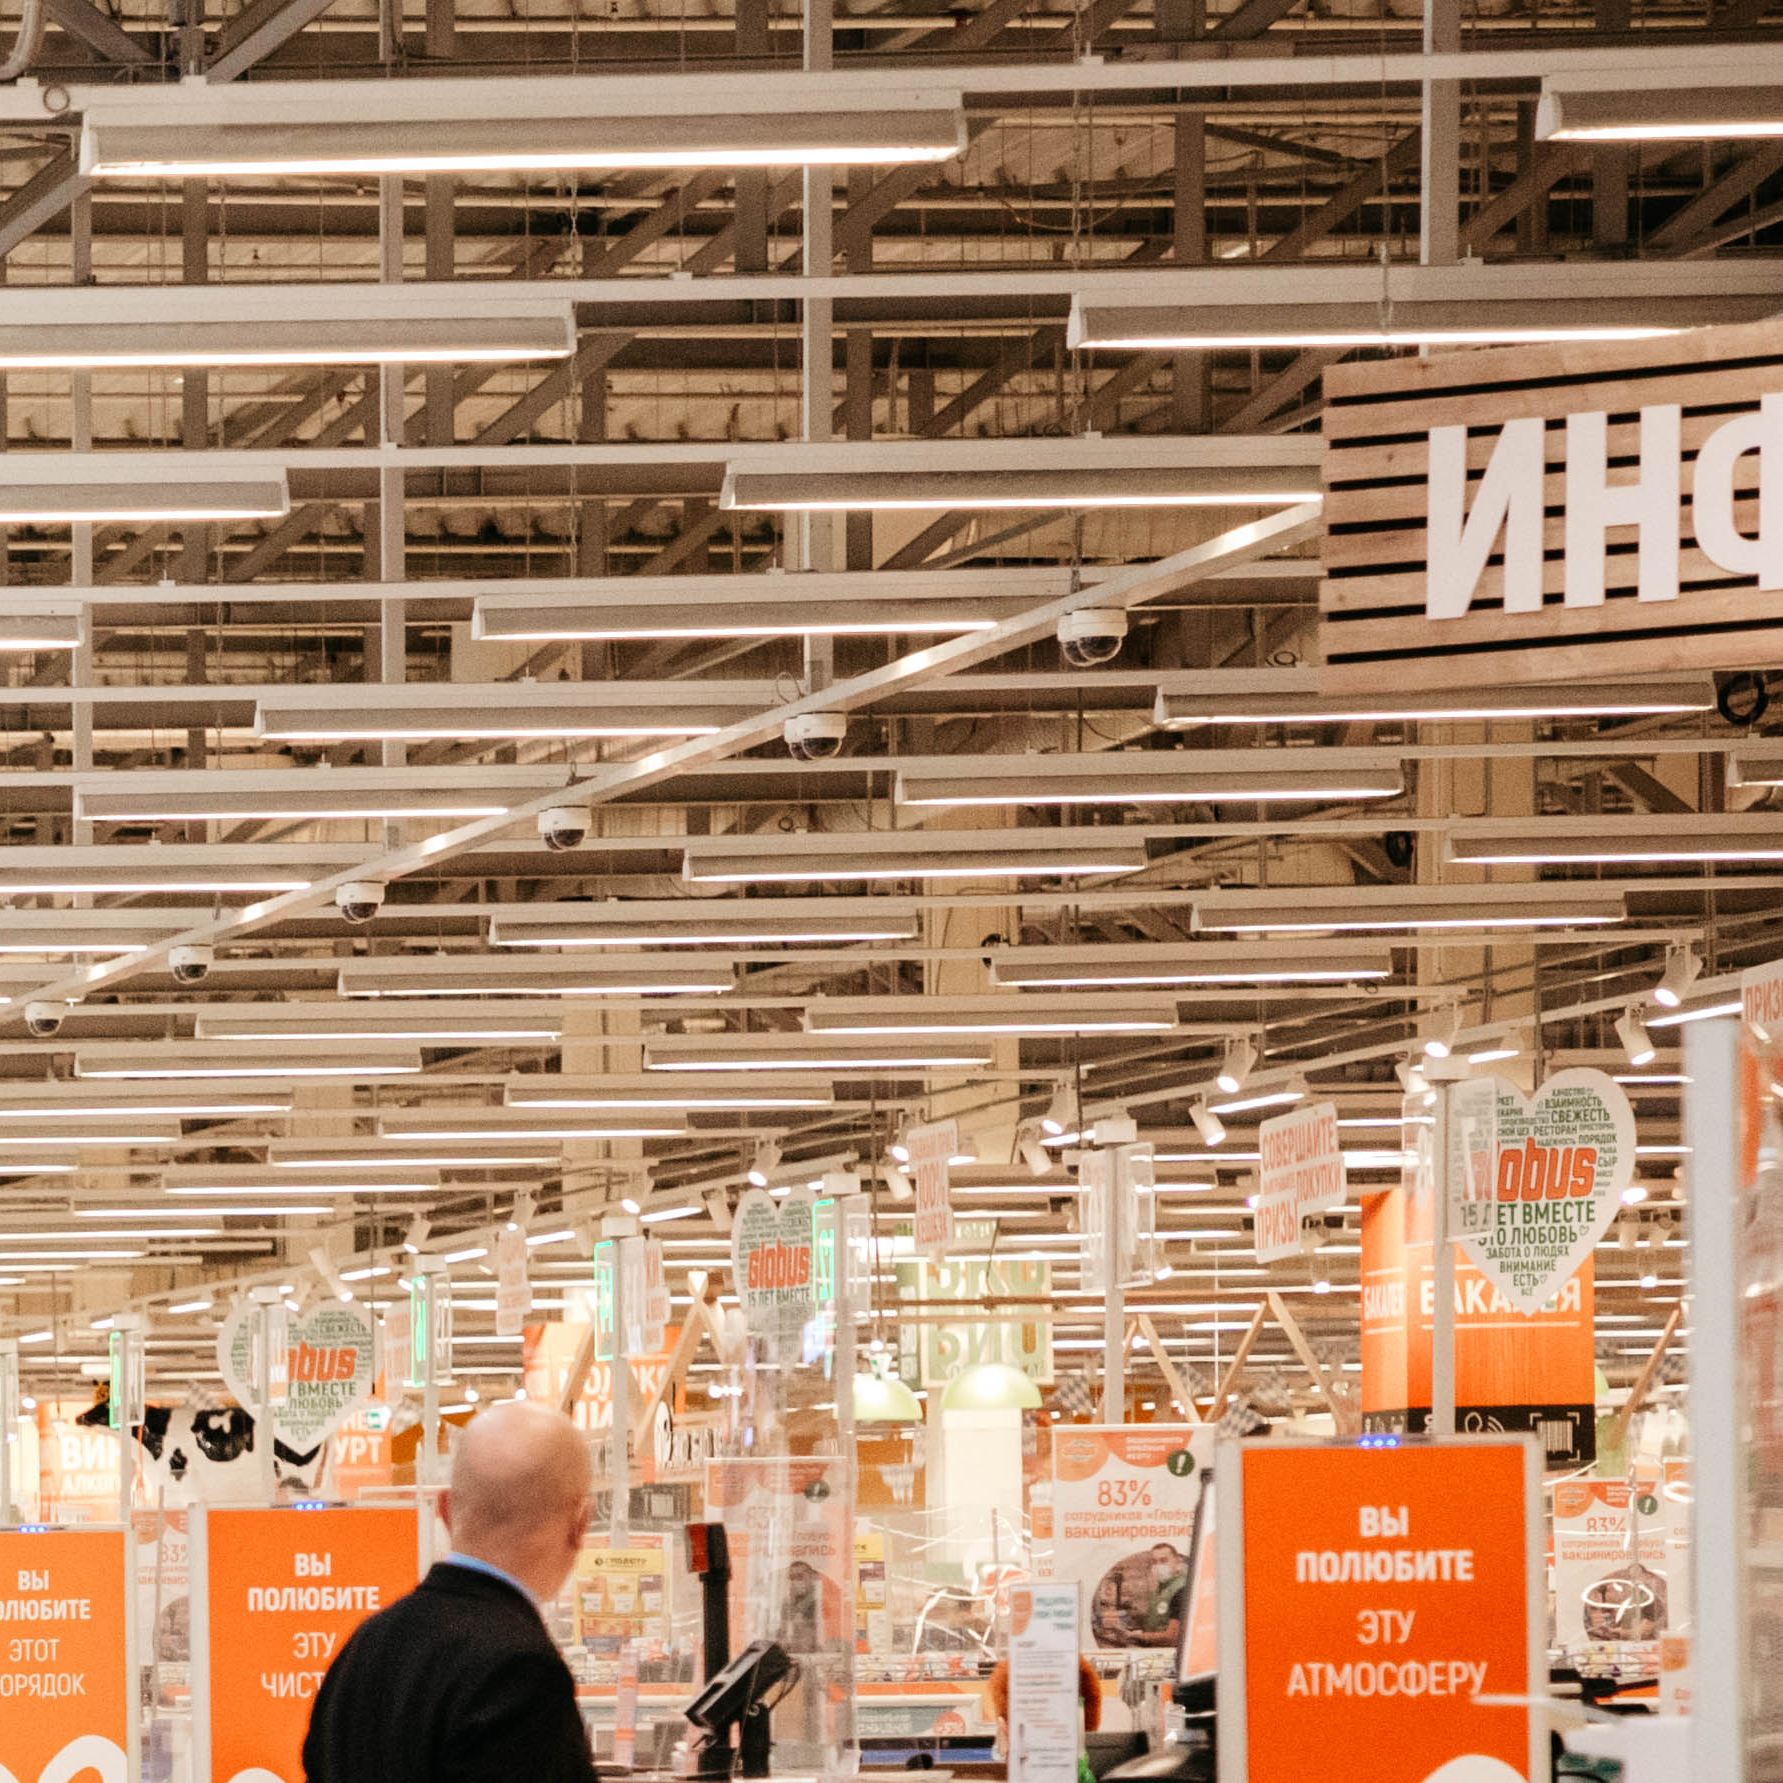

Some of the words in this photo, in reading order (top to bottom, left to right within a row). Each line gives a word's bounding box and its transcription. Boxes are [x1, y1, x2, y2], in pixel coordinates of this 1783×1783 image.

[1545, 1096, 1603, 1109] ВЗАИМНОСТЬ
[1551, 1108, 1610, 1123] СВЕЖЕСТЬ
[1533, 1124, 1578, 1137] РЕСТОРАН
[1578, 1133, 1618, 1145] ПОРЯДОК
[1598, 1156, 1618, 1167] СЫР
[1522, 1201, 1596, 1225] ВМЕСТЕ
[1510, 1225, 1578, 1246] ЛЮБОВЬ
[1485, 1246, 1522, 1259] ЗАБОТА
[1533, 1245, 1570, 1258] ЛЮДЯХ
[1499, 1259, 1556, 1273] ВНИМАНИЕ
[1513, 1274, 1539, 1287] ЕСТЬ
[1097, 1479, 1152, 1507] 83%
[1359, 1505, 1410, 1539] ВЫ
[293, 1552, 332, 1578] ВЫ
[1295, 1548, 1475, 1584] ПОЛЮБИТЕ
[17, 1569, 51, 1592] ВЫ
[247, 1585, 381, 1613] ПОЛЮБИТЕ
[1356, 1609, 1417, 1646] ЭТУ
[8, 1638, 60, 1662] ЭТОТ
[292, 1631, 337, 1661] ЭТУ
[1286, 1660, 1490, 1699] АТМОСФЕРУ
